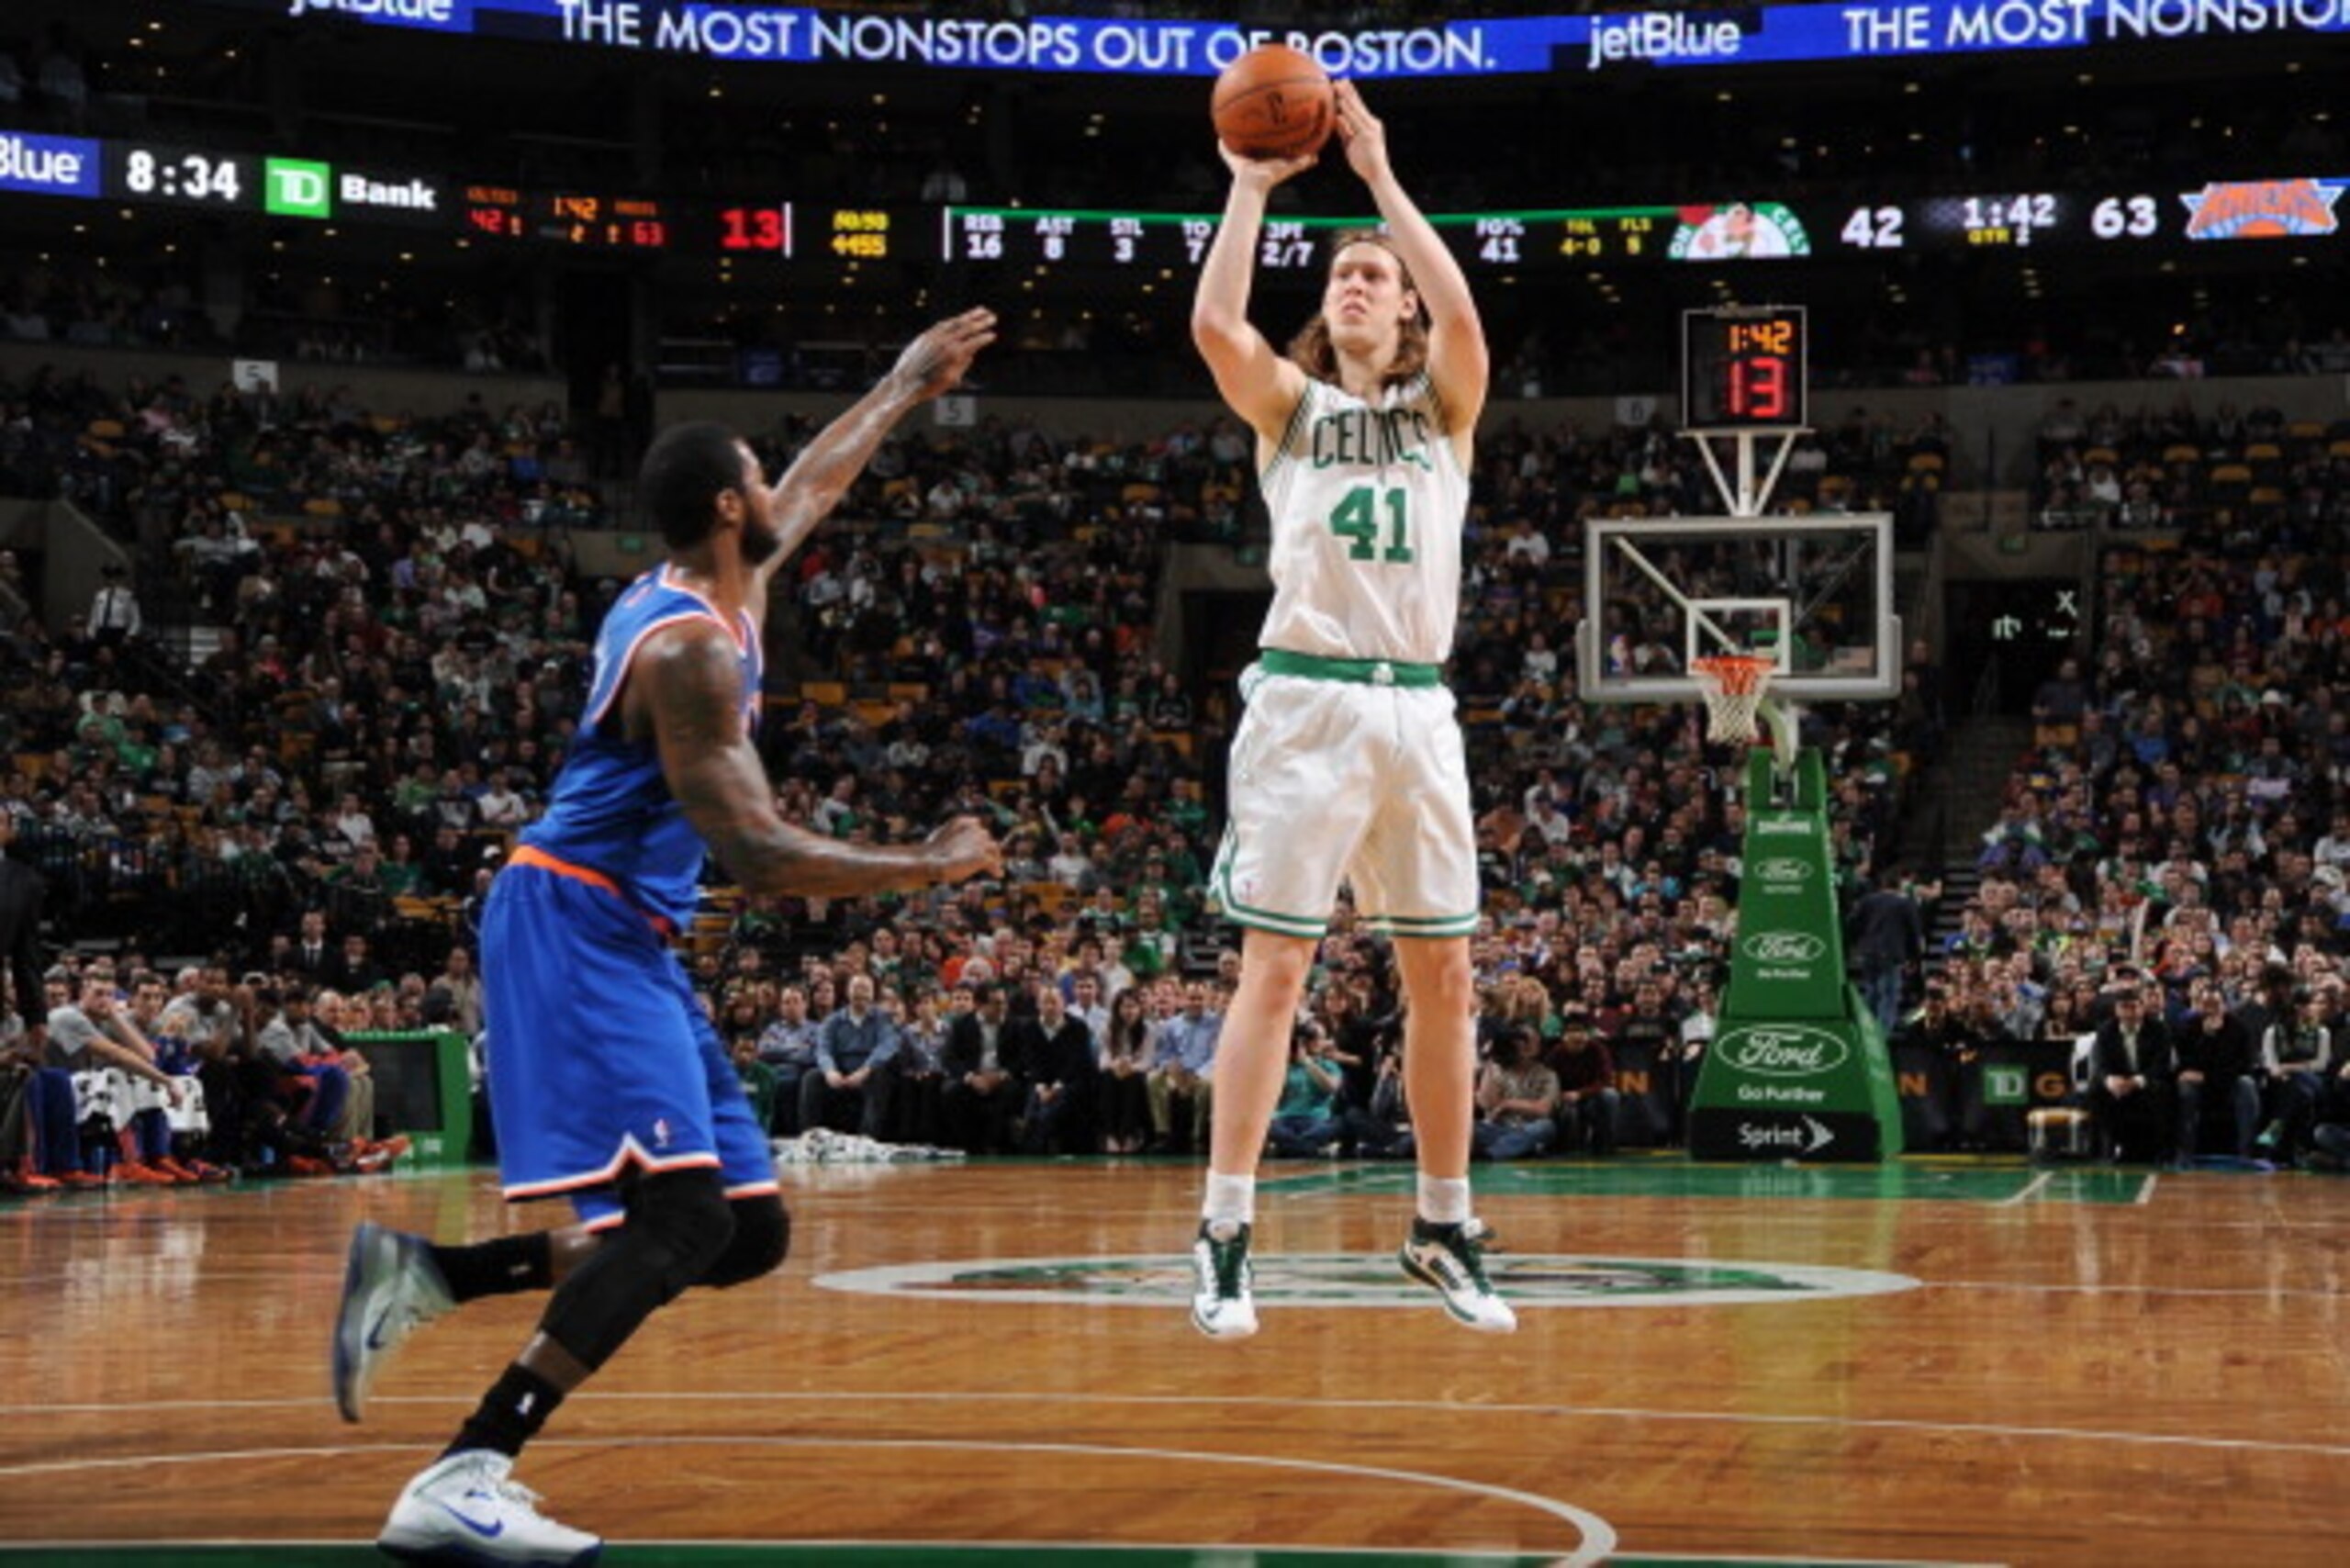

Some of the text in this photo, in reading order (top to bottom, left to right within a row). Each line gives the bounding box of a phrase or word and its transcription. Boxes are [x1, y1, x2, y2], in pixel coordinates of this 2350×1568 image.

[555, 0, 640, 45] THE
[655, 9, 797, 56] MOST
[811, 13, 1080, 66] NONSTOPS
[1093, 25, 1194, 70] OUT
[1587, 12, 1740, 71] jetBlue
[1842, 7, 1930, 51] THE
[1945, 0, 2087, 46] MOST
[126, 150, 240, 201] 8:34
[273, 169, 323, 205] TD
[341, 174, 436, 209] Bank
[721, 209, 782, 248] 13
[1841, 207, 1904, 247] 42
[1963, 194, 2056, 228] 1:42
[2091, 196, 2158, 239] 63
[967, 233, 1002, 259] 16
[1114, 237, 1134, 262] 3
[1186, 241, 1204, 263] 7
[1260, 241, 1313, 267] 2/7
[1480, 236, 1520, 262] 41
[1729, 320, 1792, 354] 1:42
[1729, 357, 1784, 418] 13
[1330, 485, 1414, 564] 41
[1739, 1030, 1824, 1066] Ford
[1738, 1084, 1825, 1102] Go Further
[1739, 1123, 1803, 1148] Sprint
